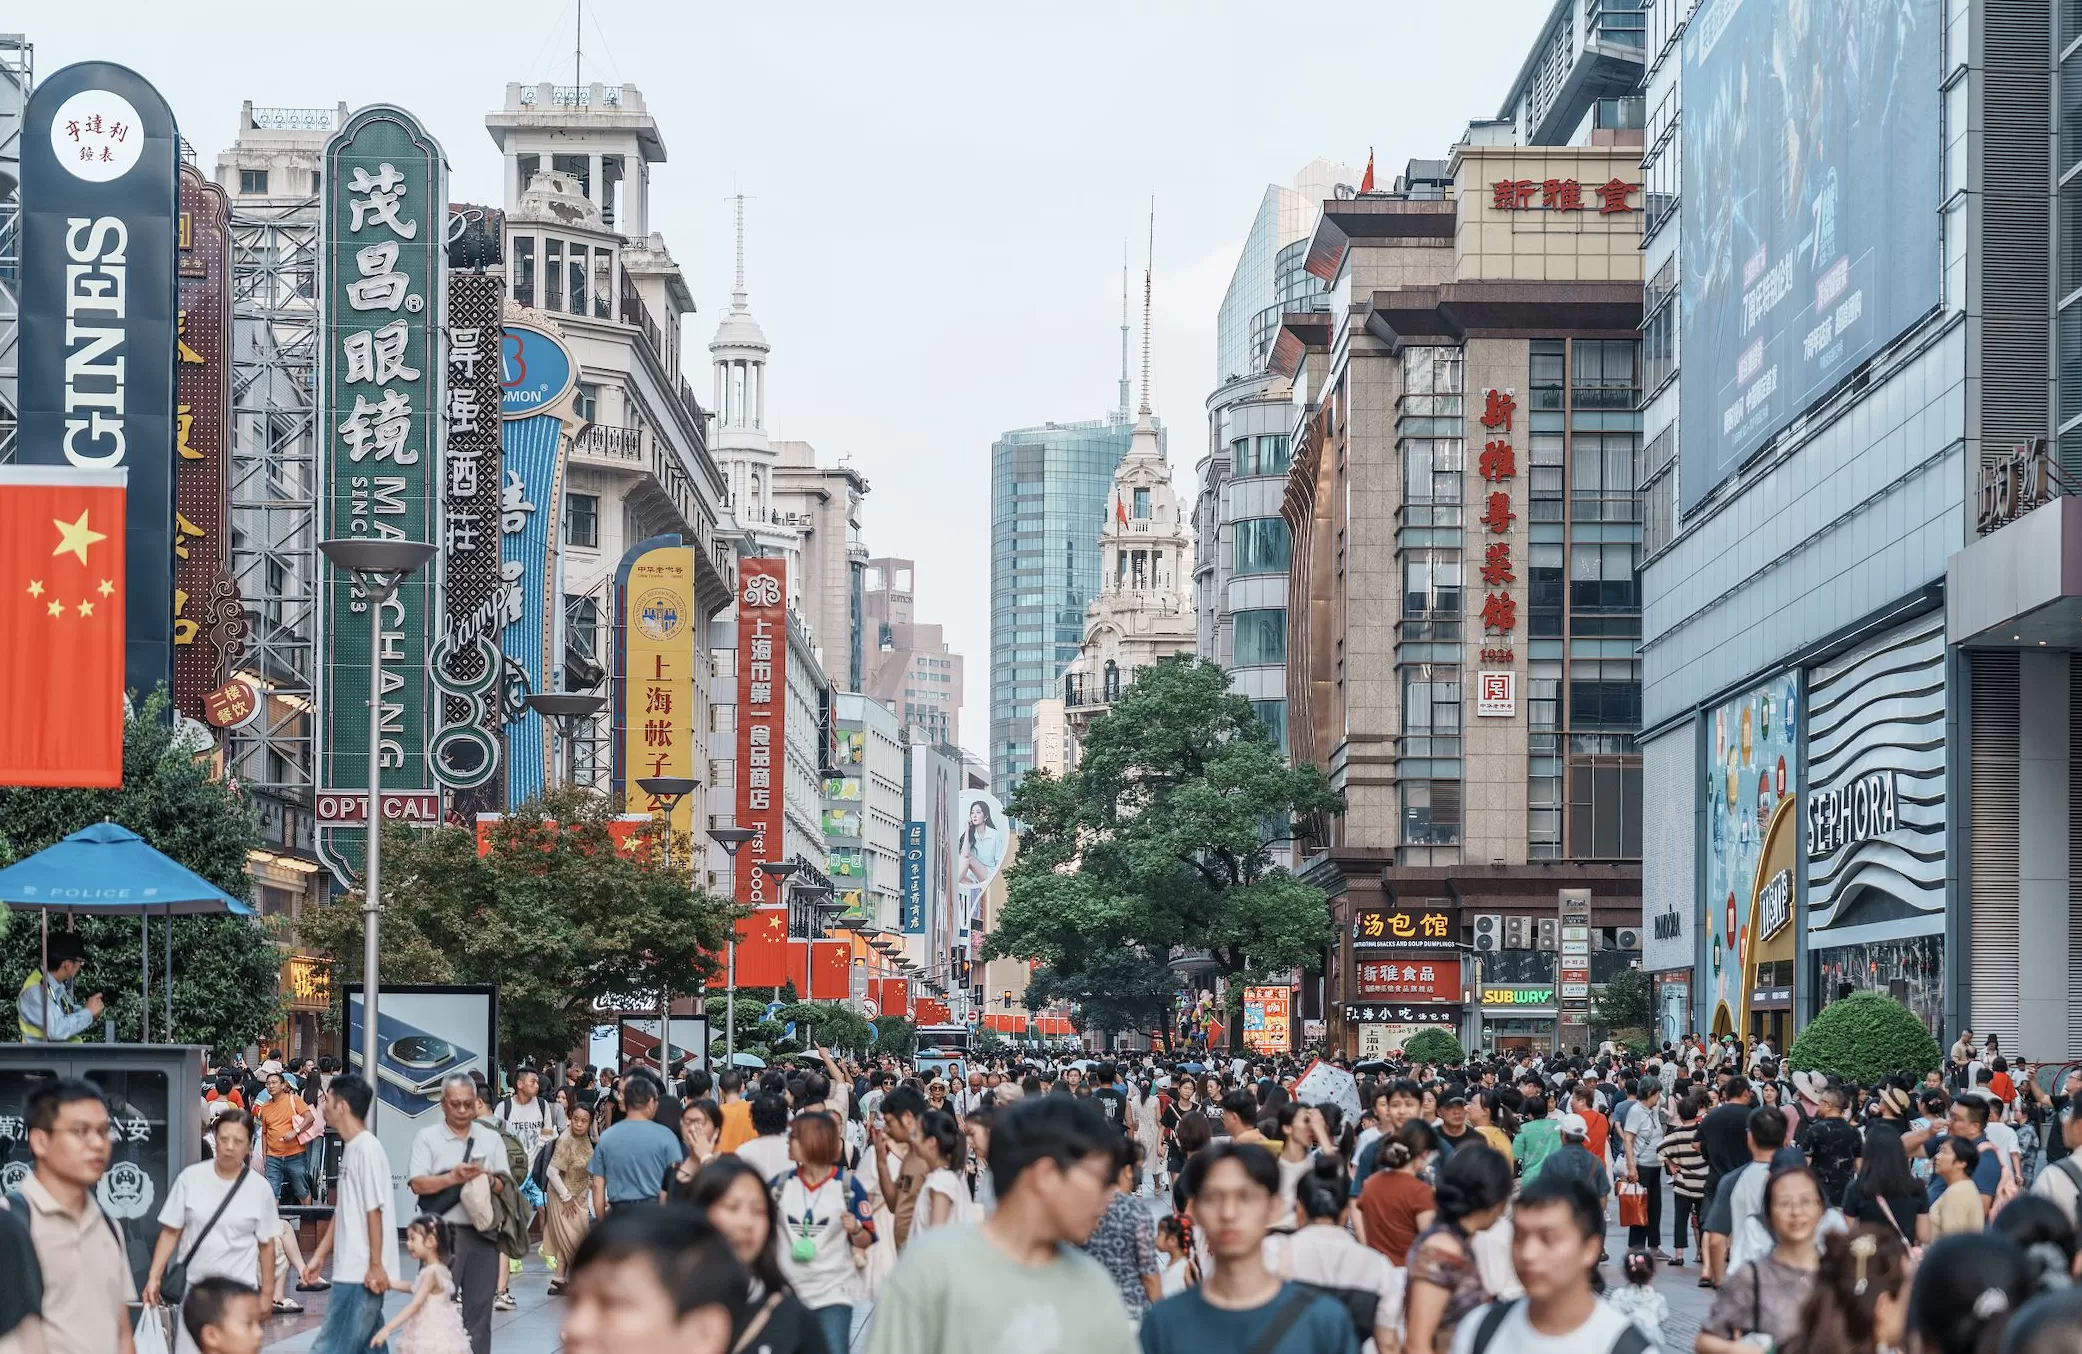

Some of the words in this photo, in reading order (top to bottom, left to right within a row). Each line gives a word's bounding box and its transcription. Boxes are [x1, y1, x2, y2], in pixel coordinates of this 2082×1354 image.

[1493, 177, 1638, 215] 新雅食
[350, 476, 368, 540] SINC
[890, 595, 914, 605] EDITION
[1480, 648, 1514, 663] 1926
[209, 684, 242, 708] 二楼
[216, 700, 249, 724] 餐饮
[750, 618, 772, 811] 上海市第一食品商店
[318, 797, 436, 819] OPTCAL
[1807, 770, 1896, 854] SEPHORA
[50, 888, 131, 898] POLICE
[1363, 912, 1449, 937] 汤包馆
[1363, 964, 1435, 982] 新雅食品
[1482, 989, 1553, 1005] SUBWAY
